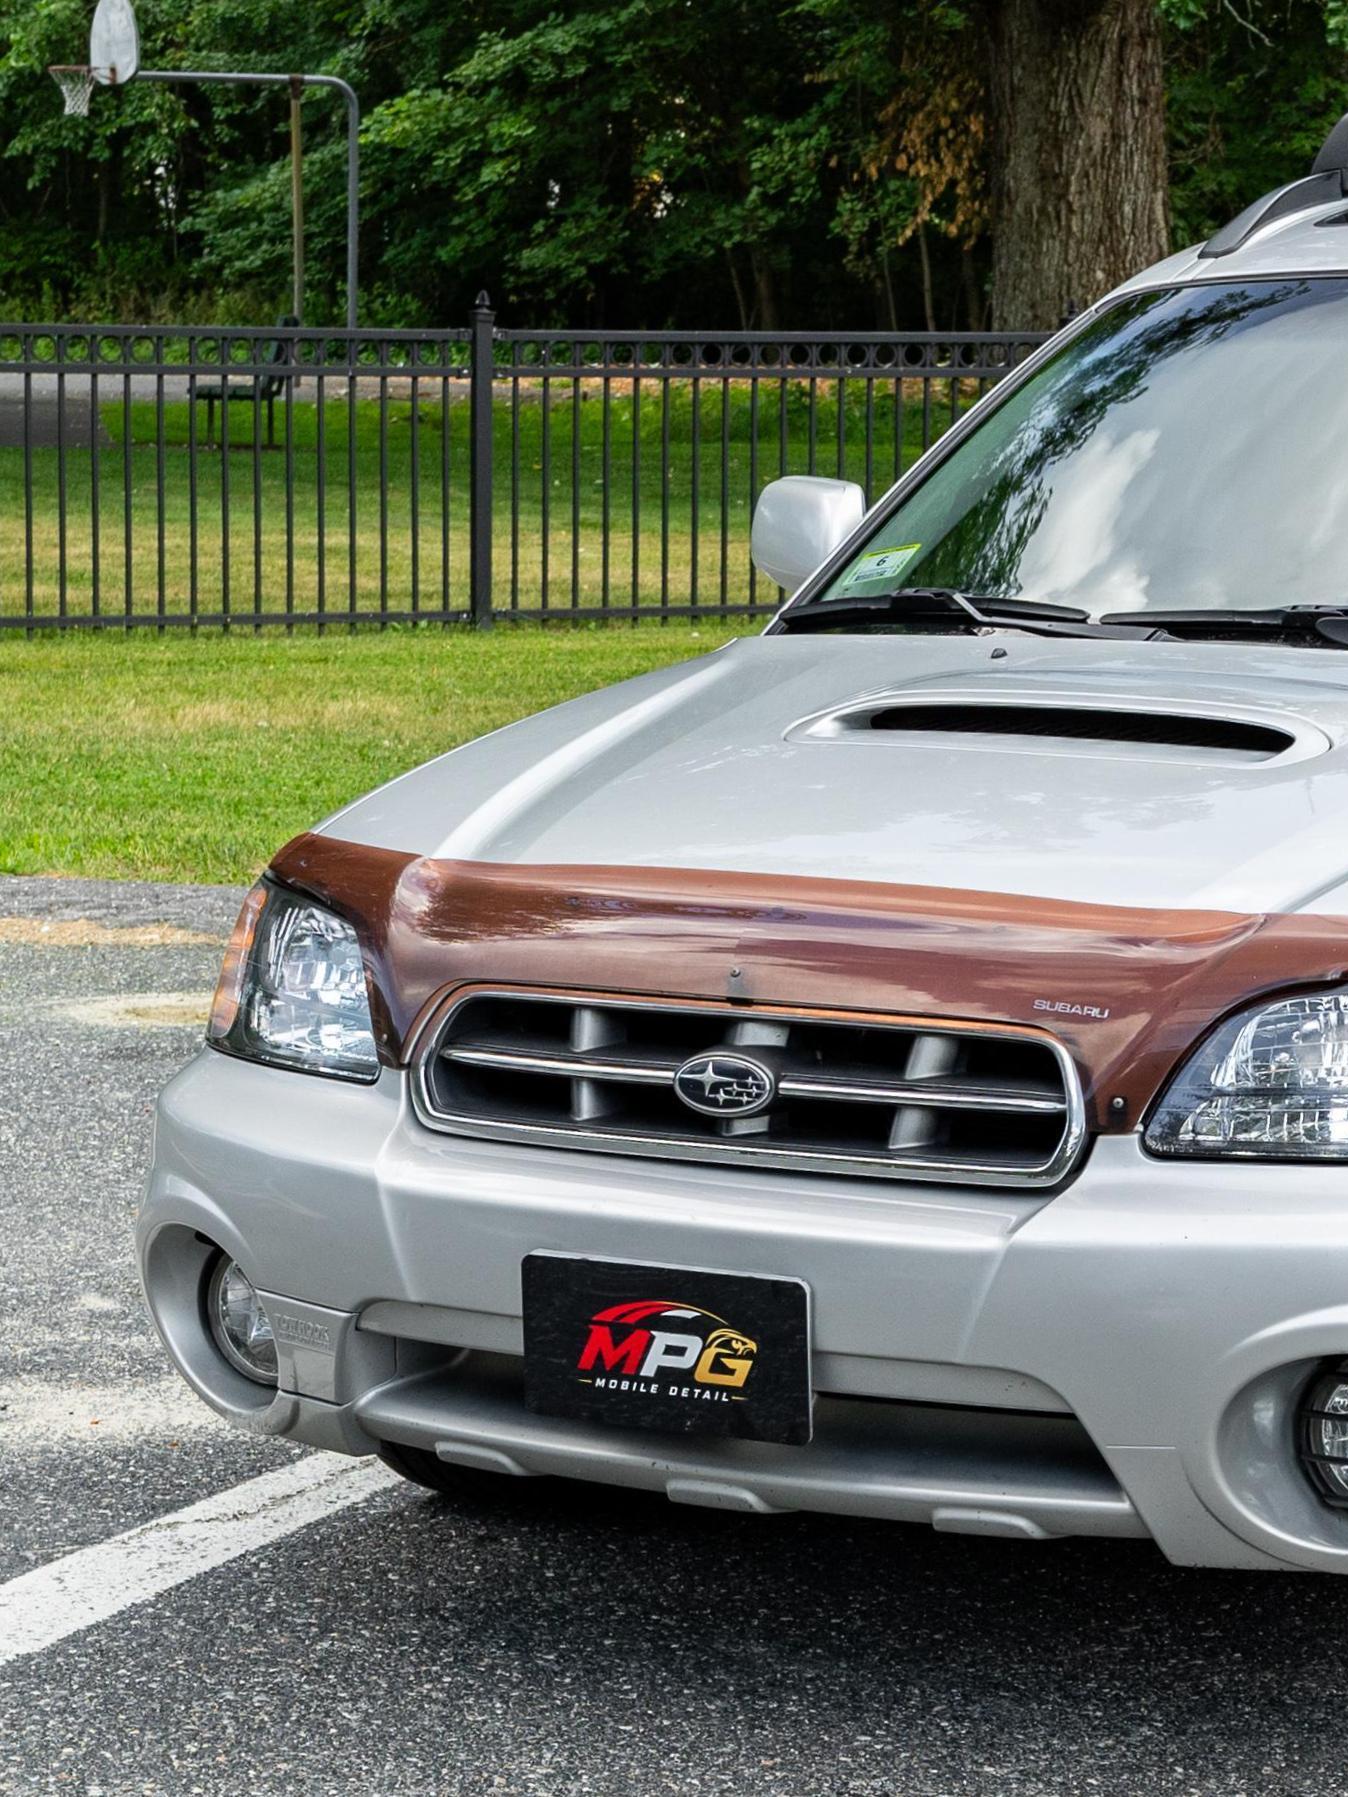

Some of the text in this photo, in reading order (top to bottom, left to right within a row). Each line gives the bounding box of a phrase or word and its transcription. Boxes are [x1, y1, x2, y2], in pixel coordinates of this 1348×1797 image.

[875, 555, 889, 567] 6
[1032, 999, 1110, 1019] SUBARU
[577, 1325, 757, 1387] MPG
[595, 1377, 729, 1402] MOBILE DETAIL
